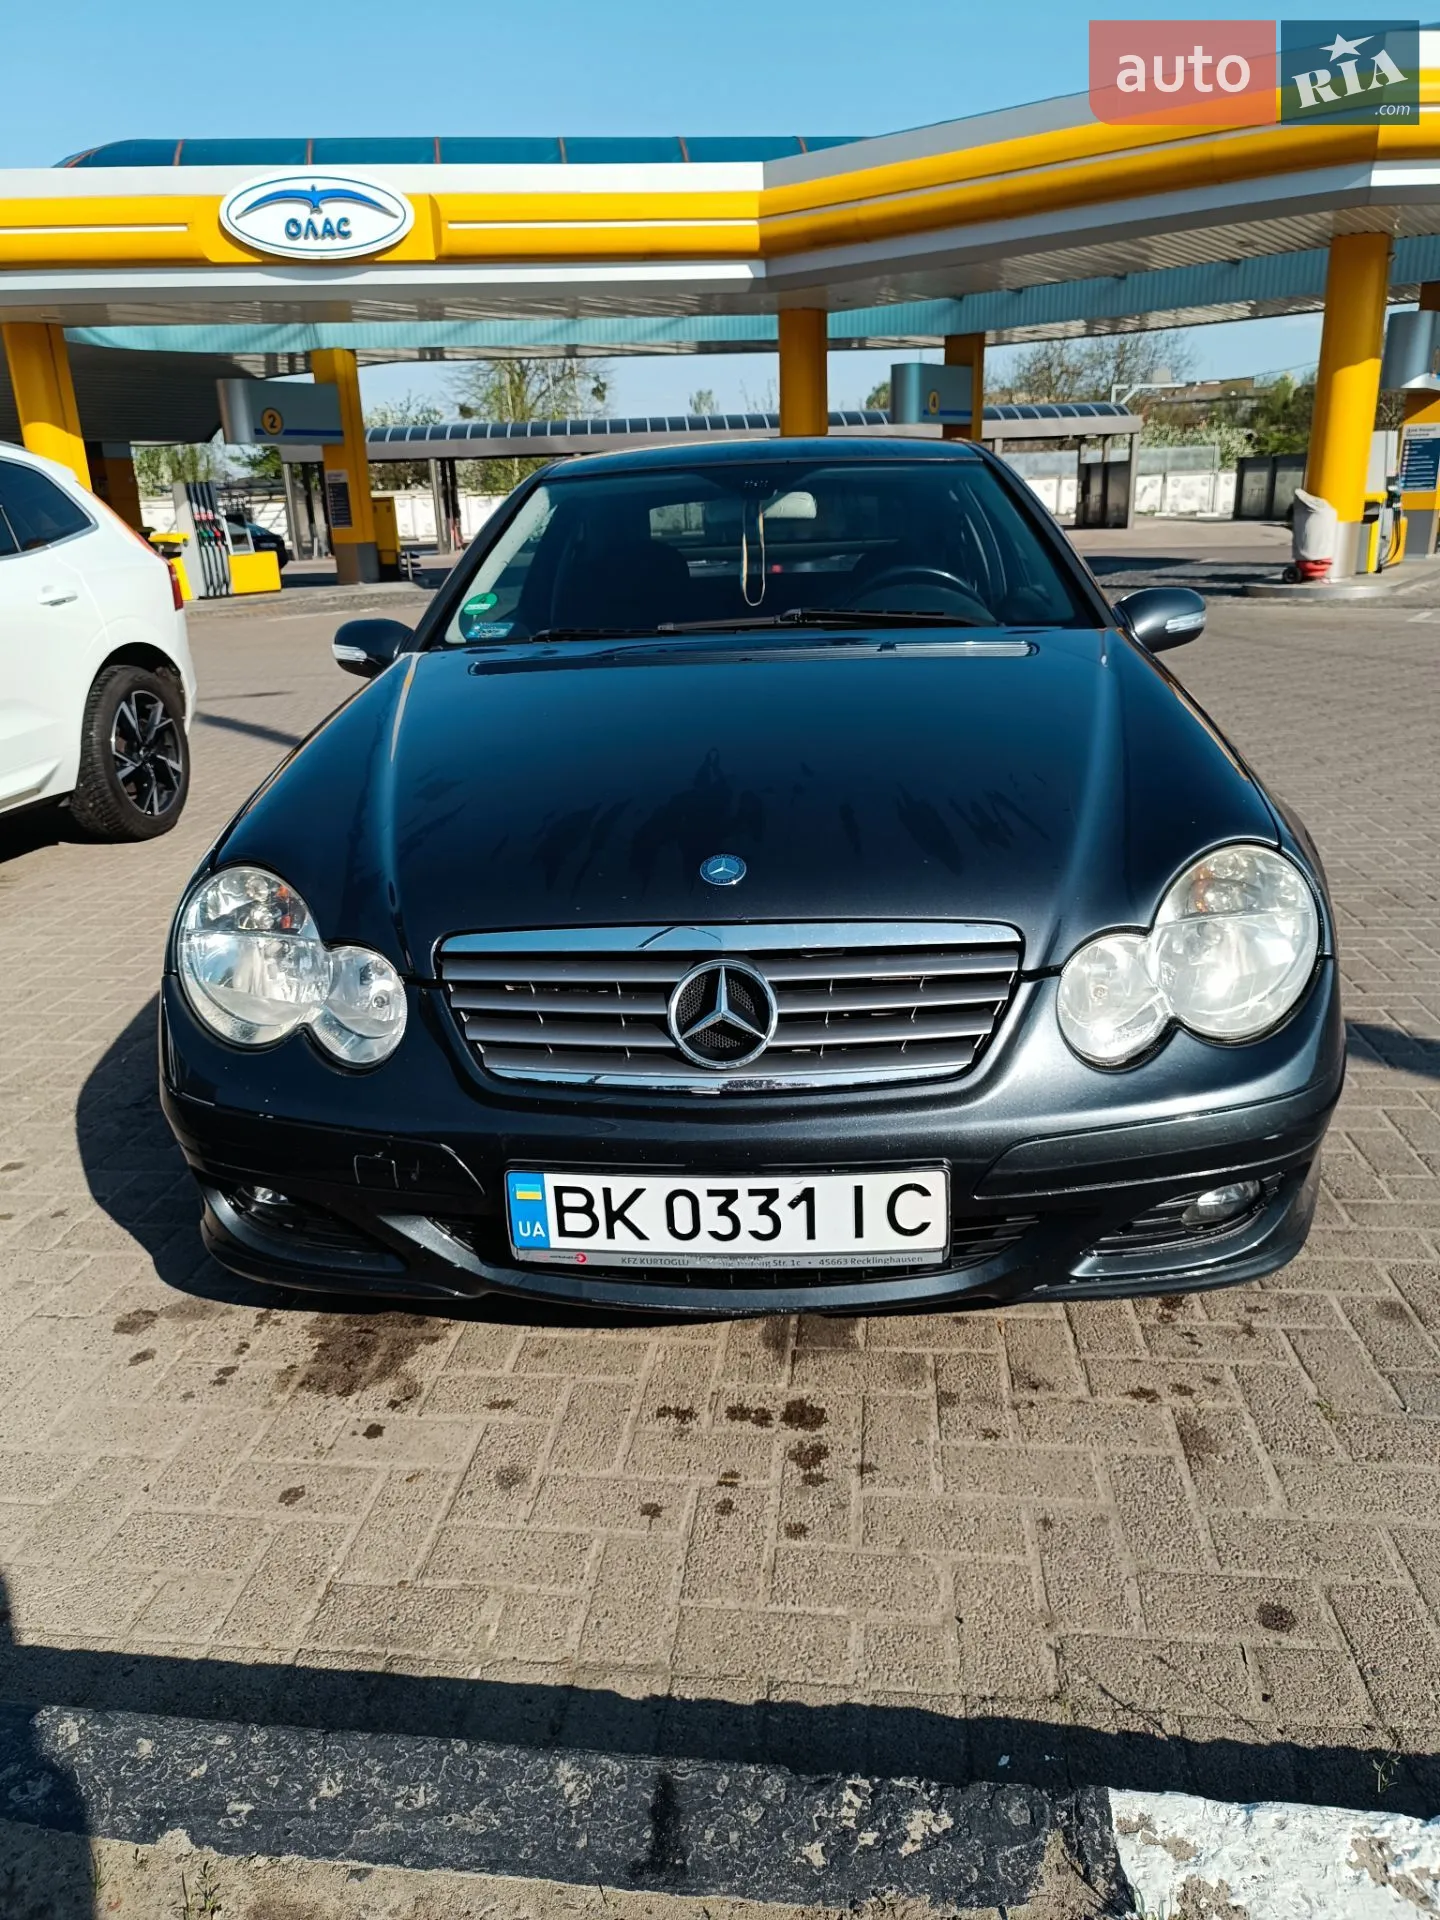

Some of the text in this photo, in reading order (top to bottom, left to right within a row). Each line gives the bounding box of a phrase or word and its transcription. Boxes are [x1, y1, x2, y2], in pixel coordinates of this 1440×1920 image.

[284, 217, 352, 241] ОЛАС
[267, 414, 278, 429] 2
[553, 1182, 932, 1241] BK 0331 IC
[518, 1220, 546, 1237] UA
[620, 1257, 638, 1265] KFZ
[850, 1256, 923, 1266] Recklinghausen
